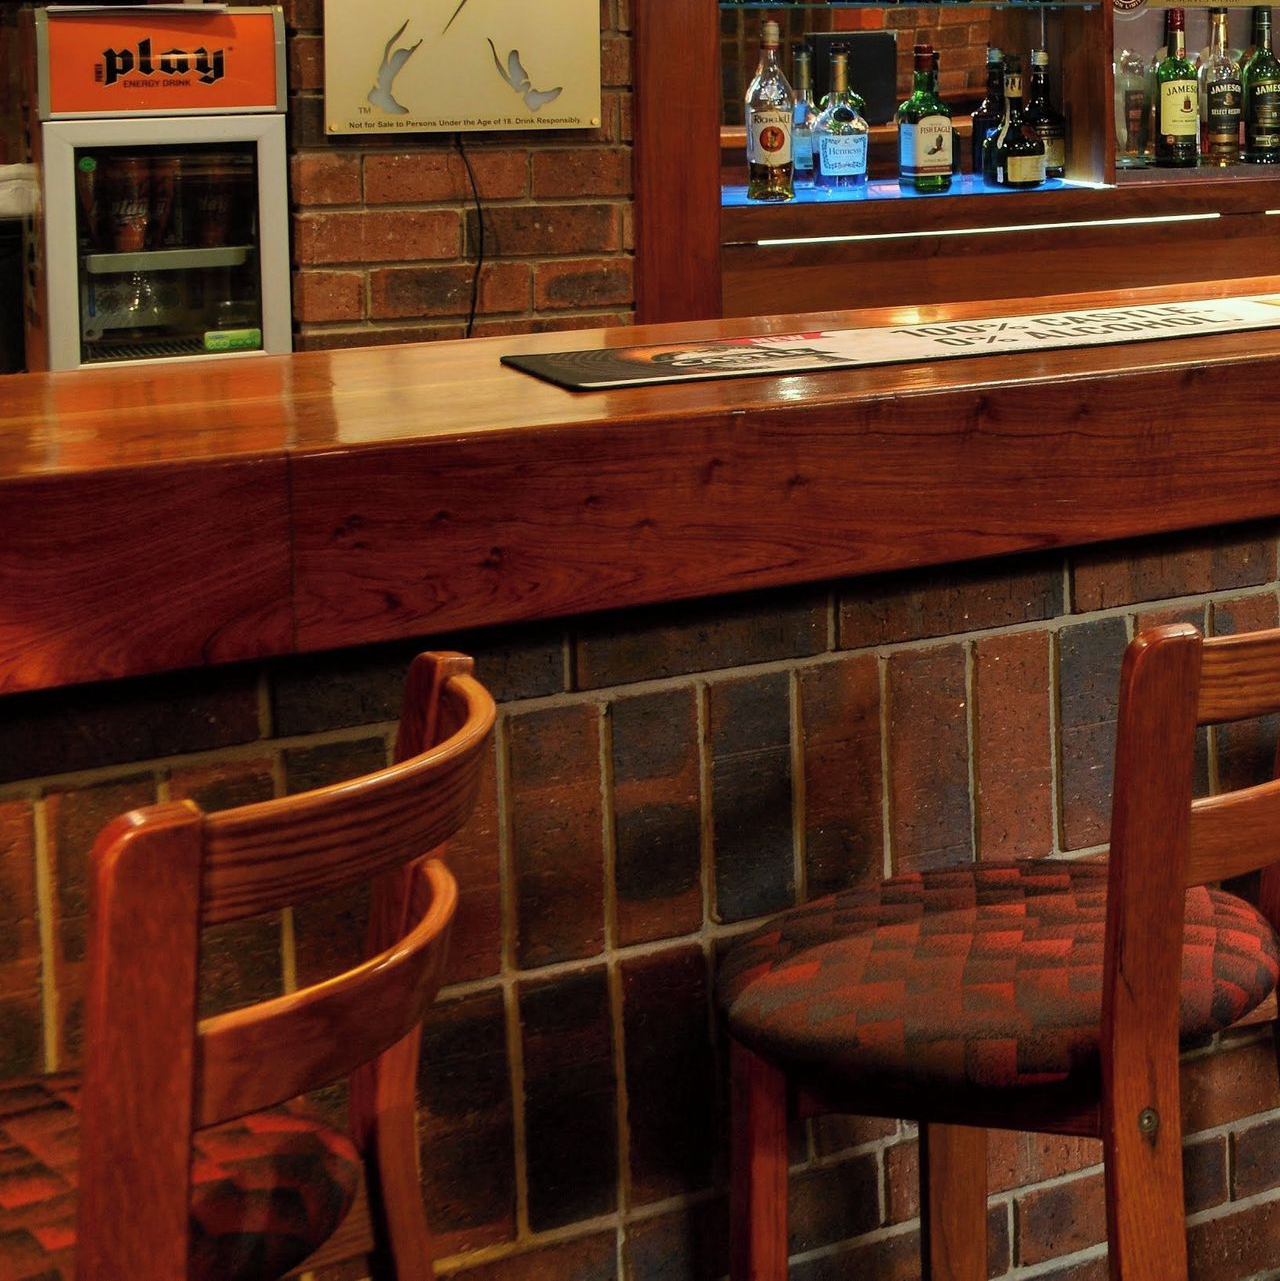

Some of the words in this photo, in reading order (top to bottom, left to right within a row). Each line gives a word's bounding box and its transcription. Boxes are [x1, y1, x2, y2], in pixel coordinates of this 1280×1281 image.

[102, 37, 225, 87] play
[123, 79, 160, 88] ENERGY
[162, 79, 191, 87] DRINK
[378, 120, 394, 128] Sale
[891, 322, 1028, 338] 100%
[933, 334, 1019, 347] 0%
